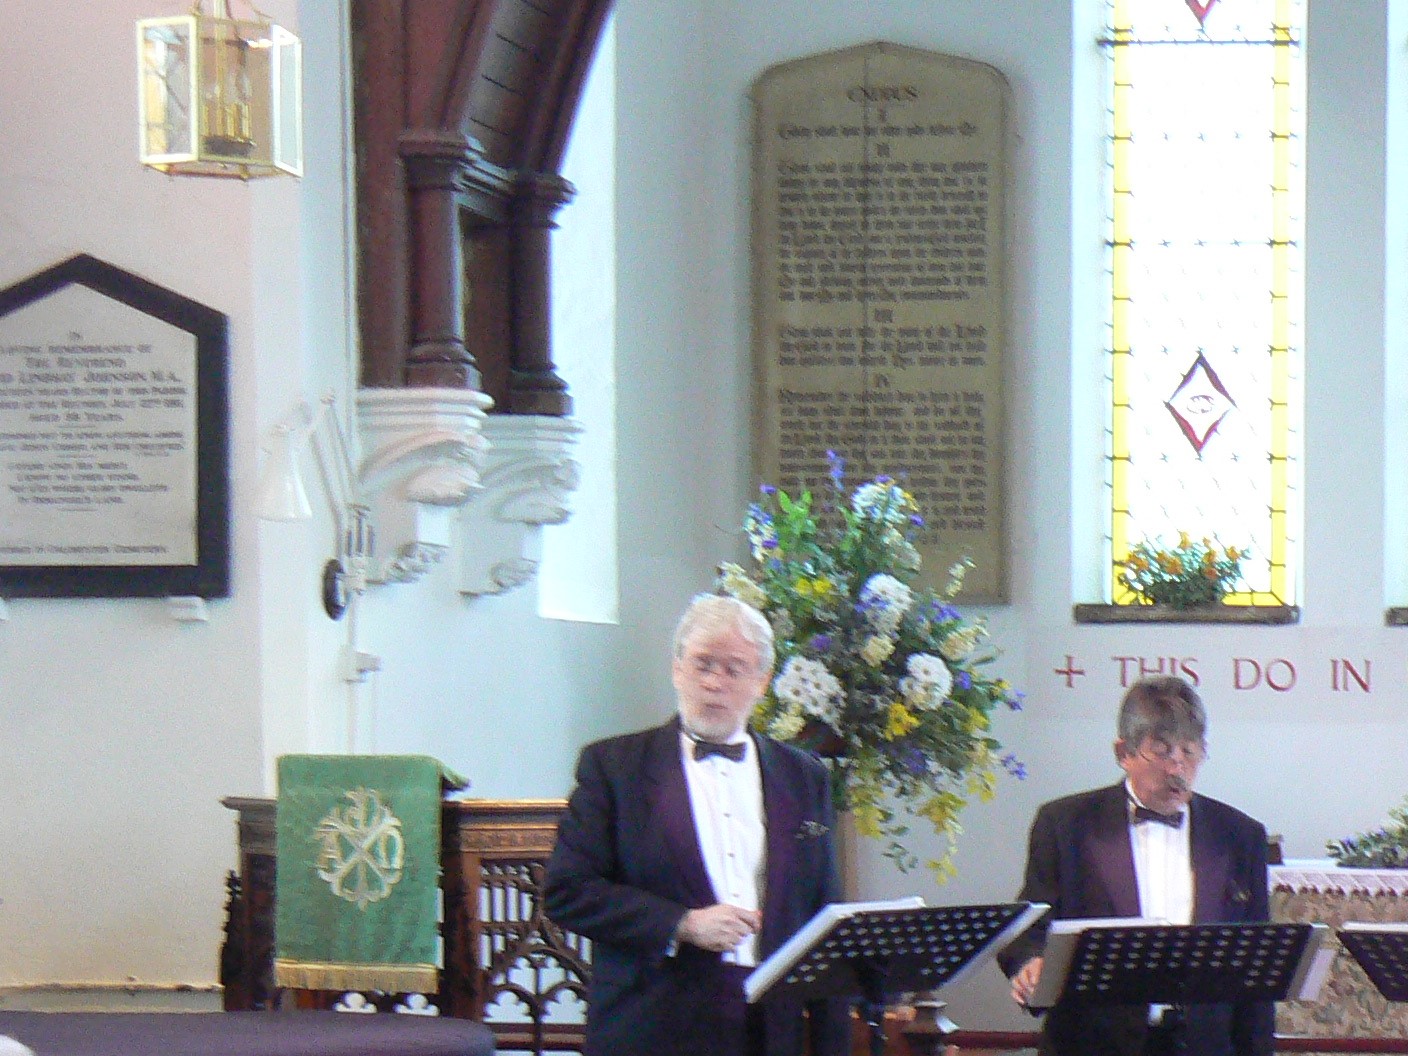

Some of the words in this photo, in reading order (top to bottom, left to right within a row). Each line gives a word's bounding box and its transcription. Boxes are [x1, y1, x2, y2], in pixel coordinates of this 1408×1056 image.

[1111, 655, 1201, 688] THIS
[1231, 657, 1298, 692] DO
[1329, 658, 1374, 693] IN
